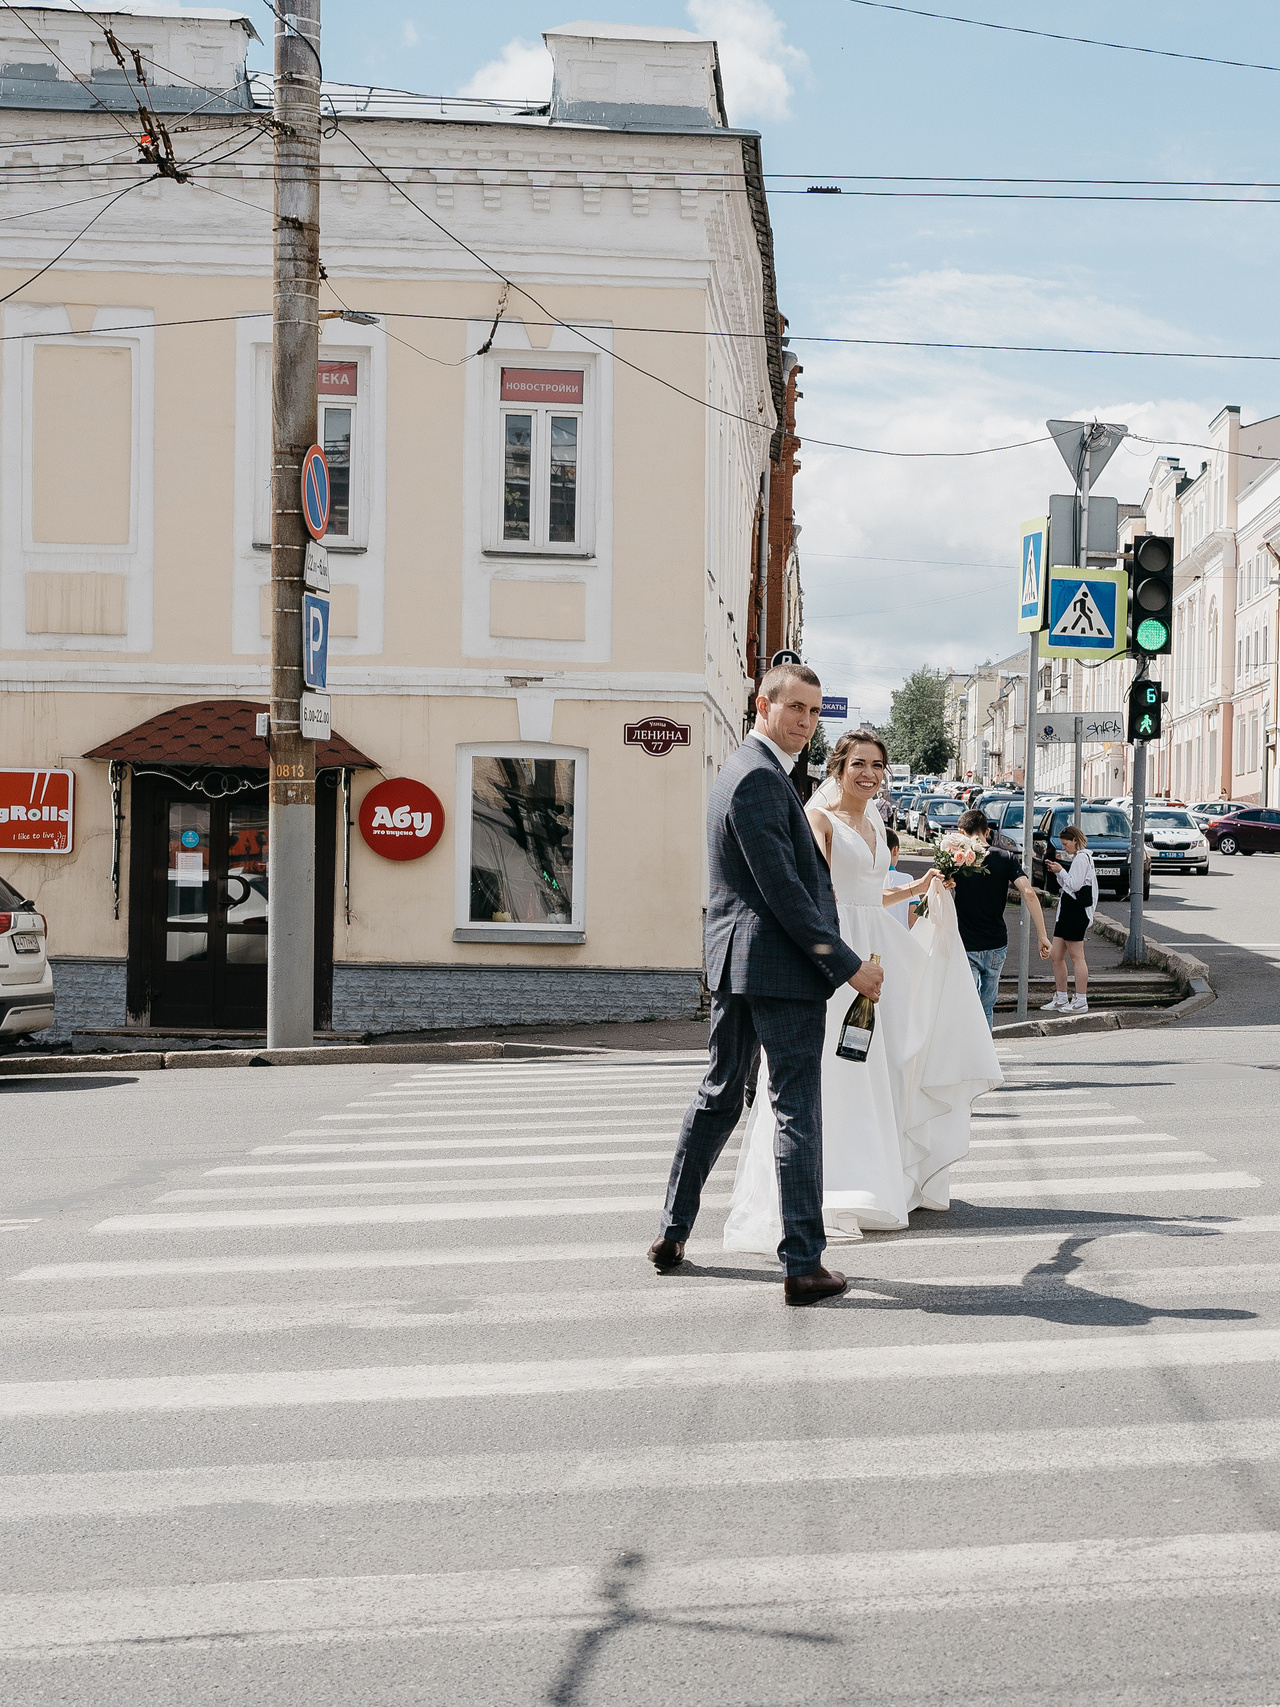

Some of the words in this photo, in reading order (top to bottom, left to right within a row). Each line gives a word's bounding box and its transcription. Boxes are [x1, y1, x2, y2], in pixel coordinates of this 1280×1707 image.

[506, 382, 579, 393] НОВОСТРОЙКИ
[1146, 688, 1156, 703] 6
[632, 730, 683, 740] ЛЕНИНА
[652, 742, 663, 751] 77
[276, 764, 304, 777] 0813
[371, 805, 432, 837] Абу
